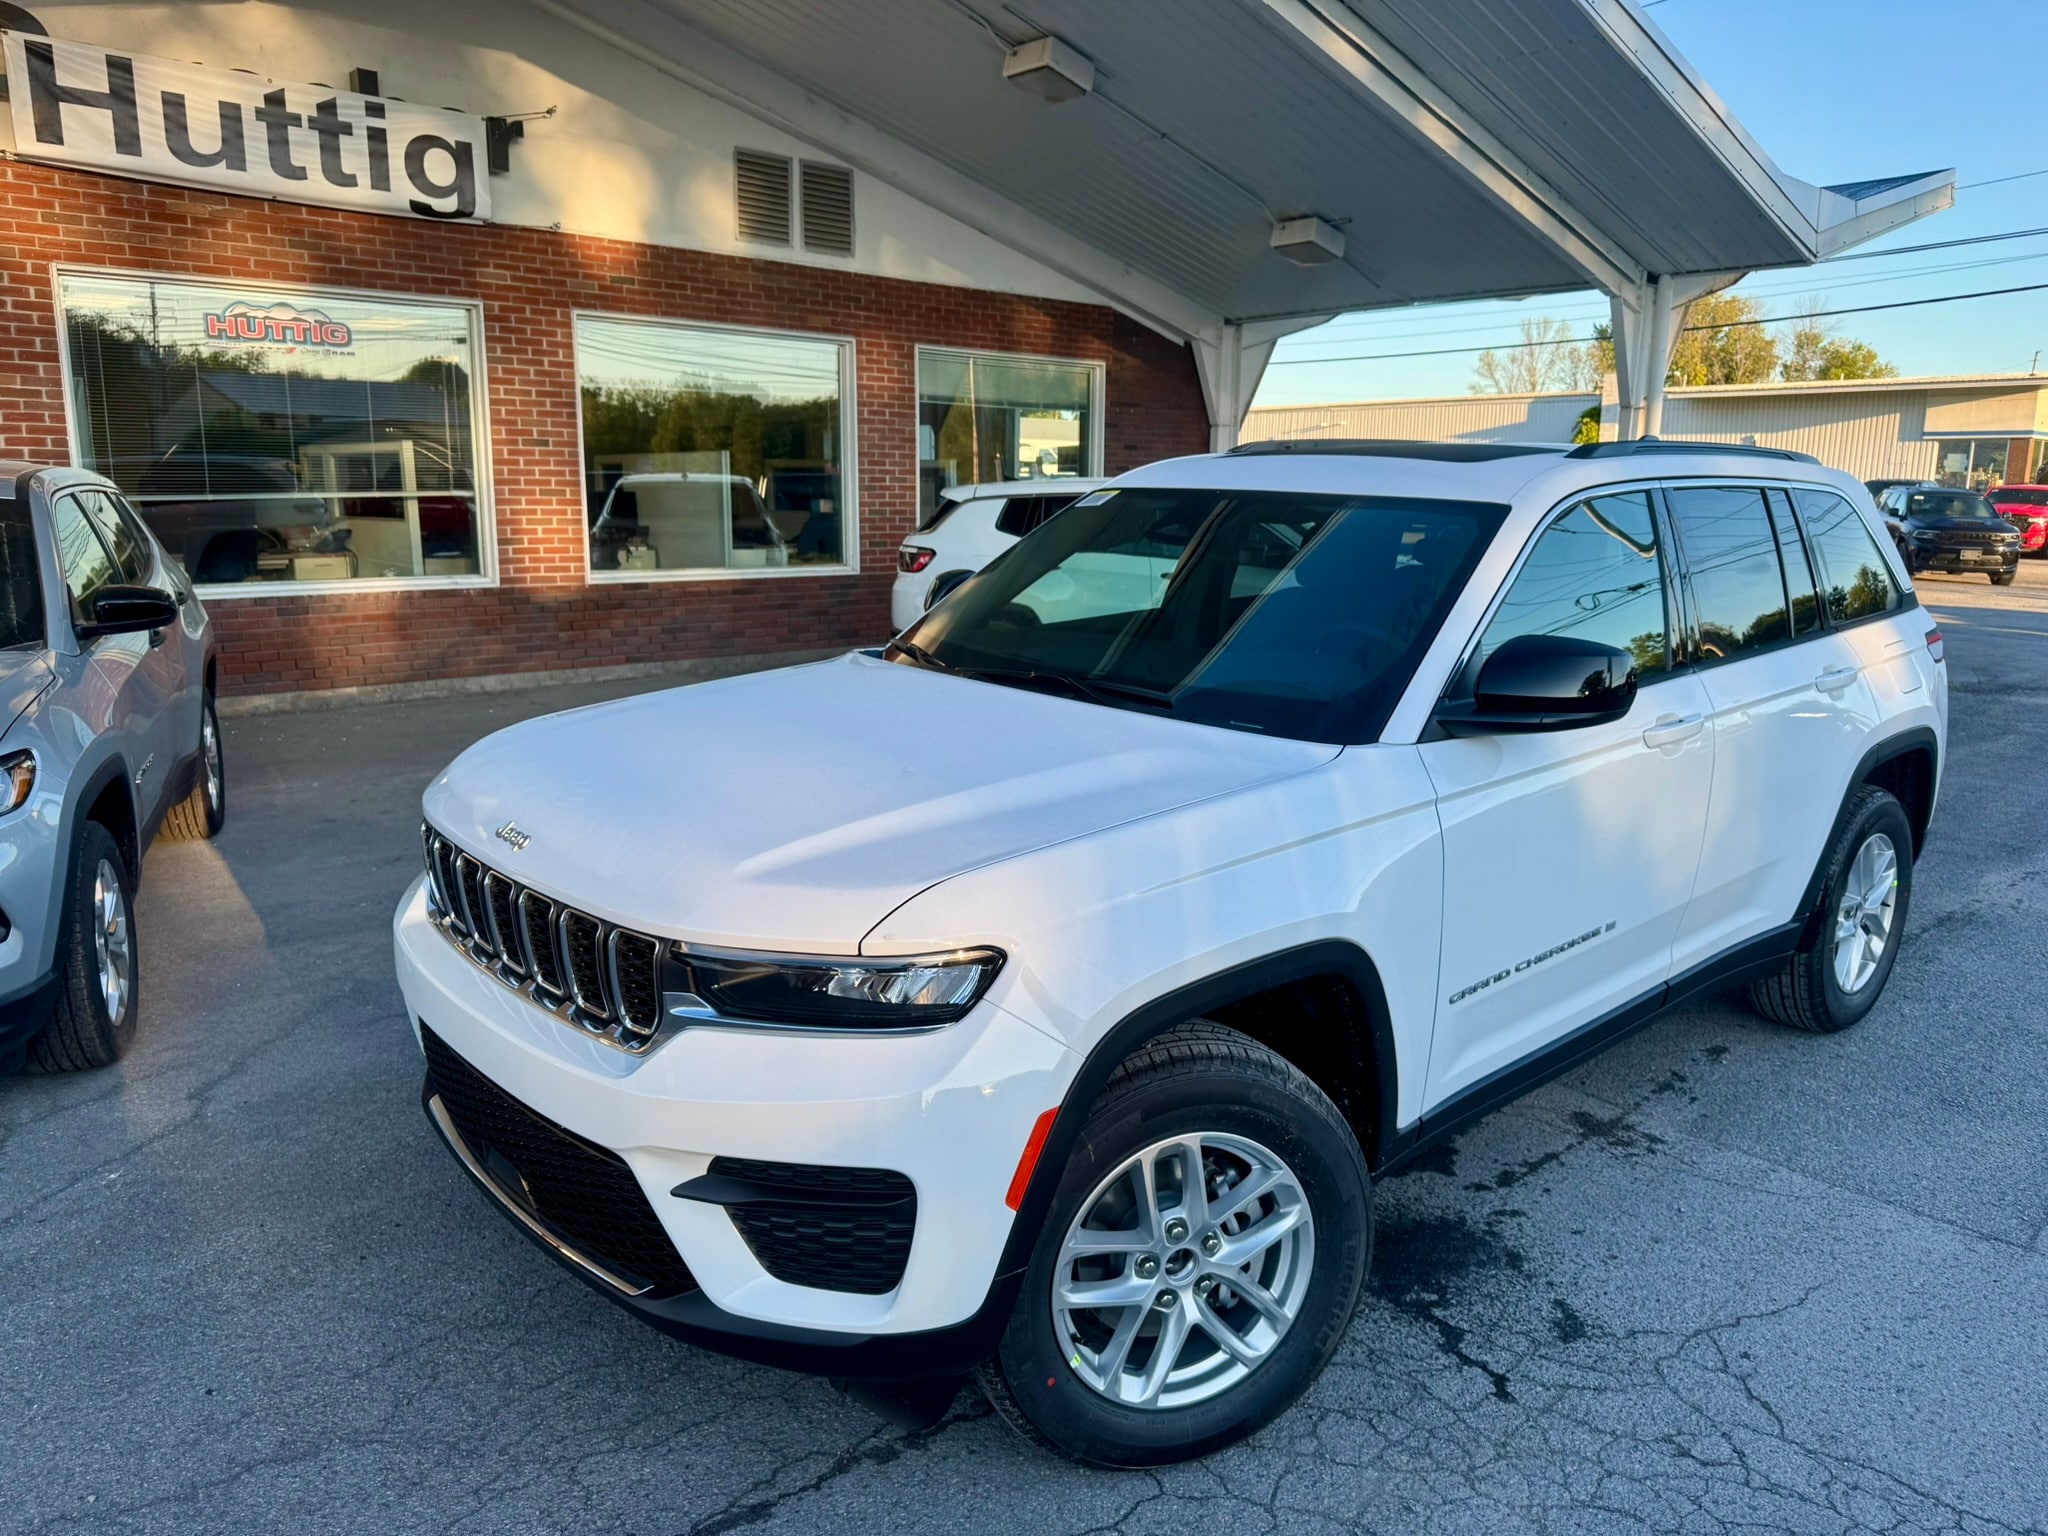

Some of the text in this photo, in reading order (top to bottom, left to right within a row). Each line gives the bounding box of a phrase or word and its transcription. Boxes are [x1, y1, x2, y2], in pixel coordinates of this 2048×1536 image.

[24, 39, 476, 219] Huttig
[206, 314, 349, 345] HUTTIG
[496, 821, 531, 852] Jeep
[1449, 926, 1602, 1005] GRAND CHEROKEE
